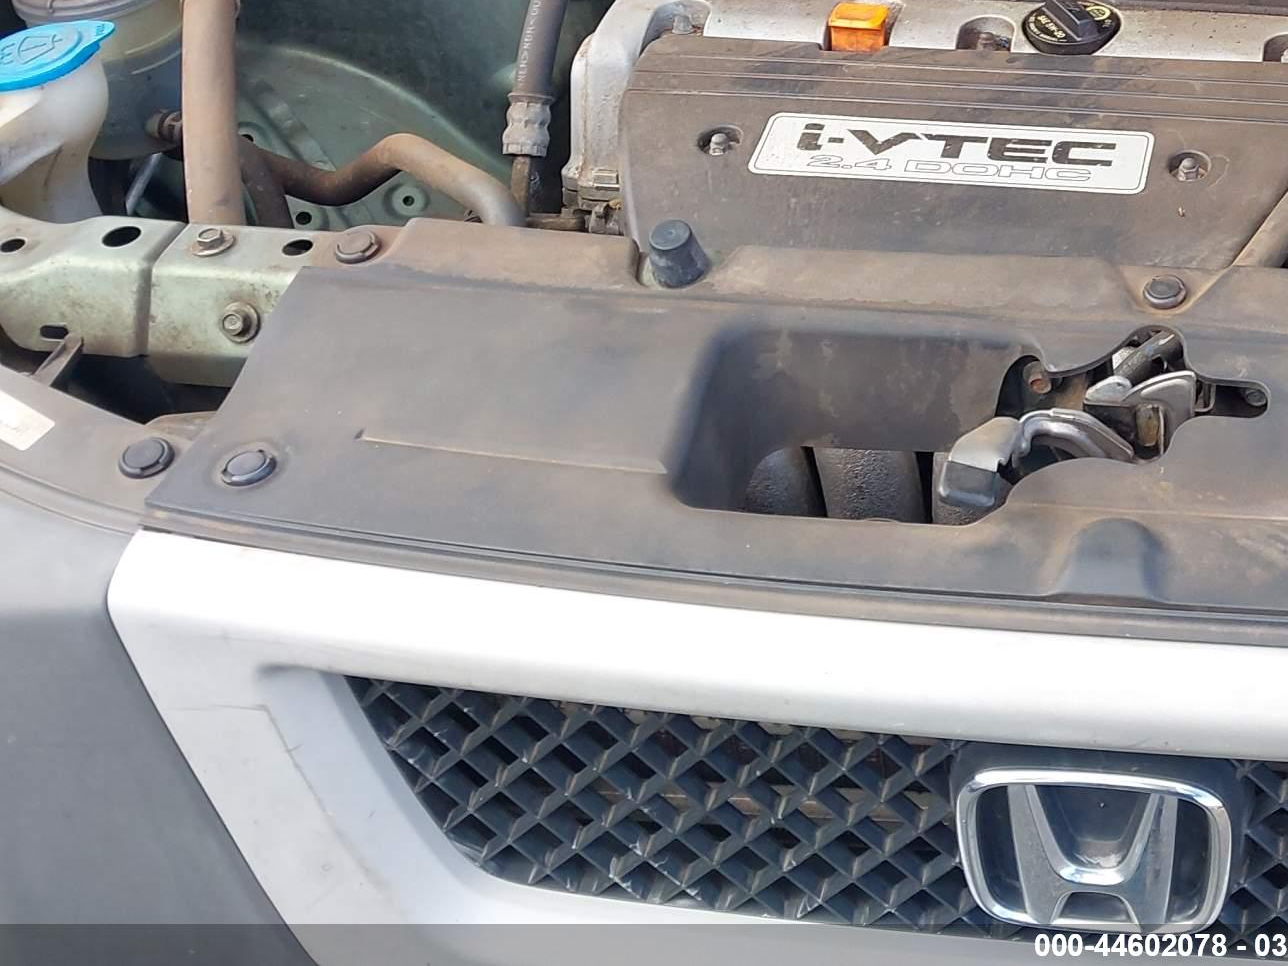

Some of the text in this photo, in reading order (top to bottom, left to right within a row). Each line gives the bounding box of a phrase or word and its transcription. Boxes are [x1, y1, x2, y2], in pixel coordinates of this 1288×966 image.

[797, 123, 1117, 167] i-VTEC
[806, 155, 1092, 182] 2.4 DOHC
